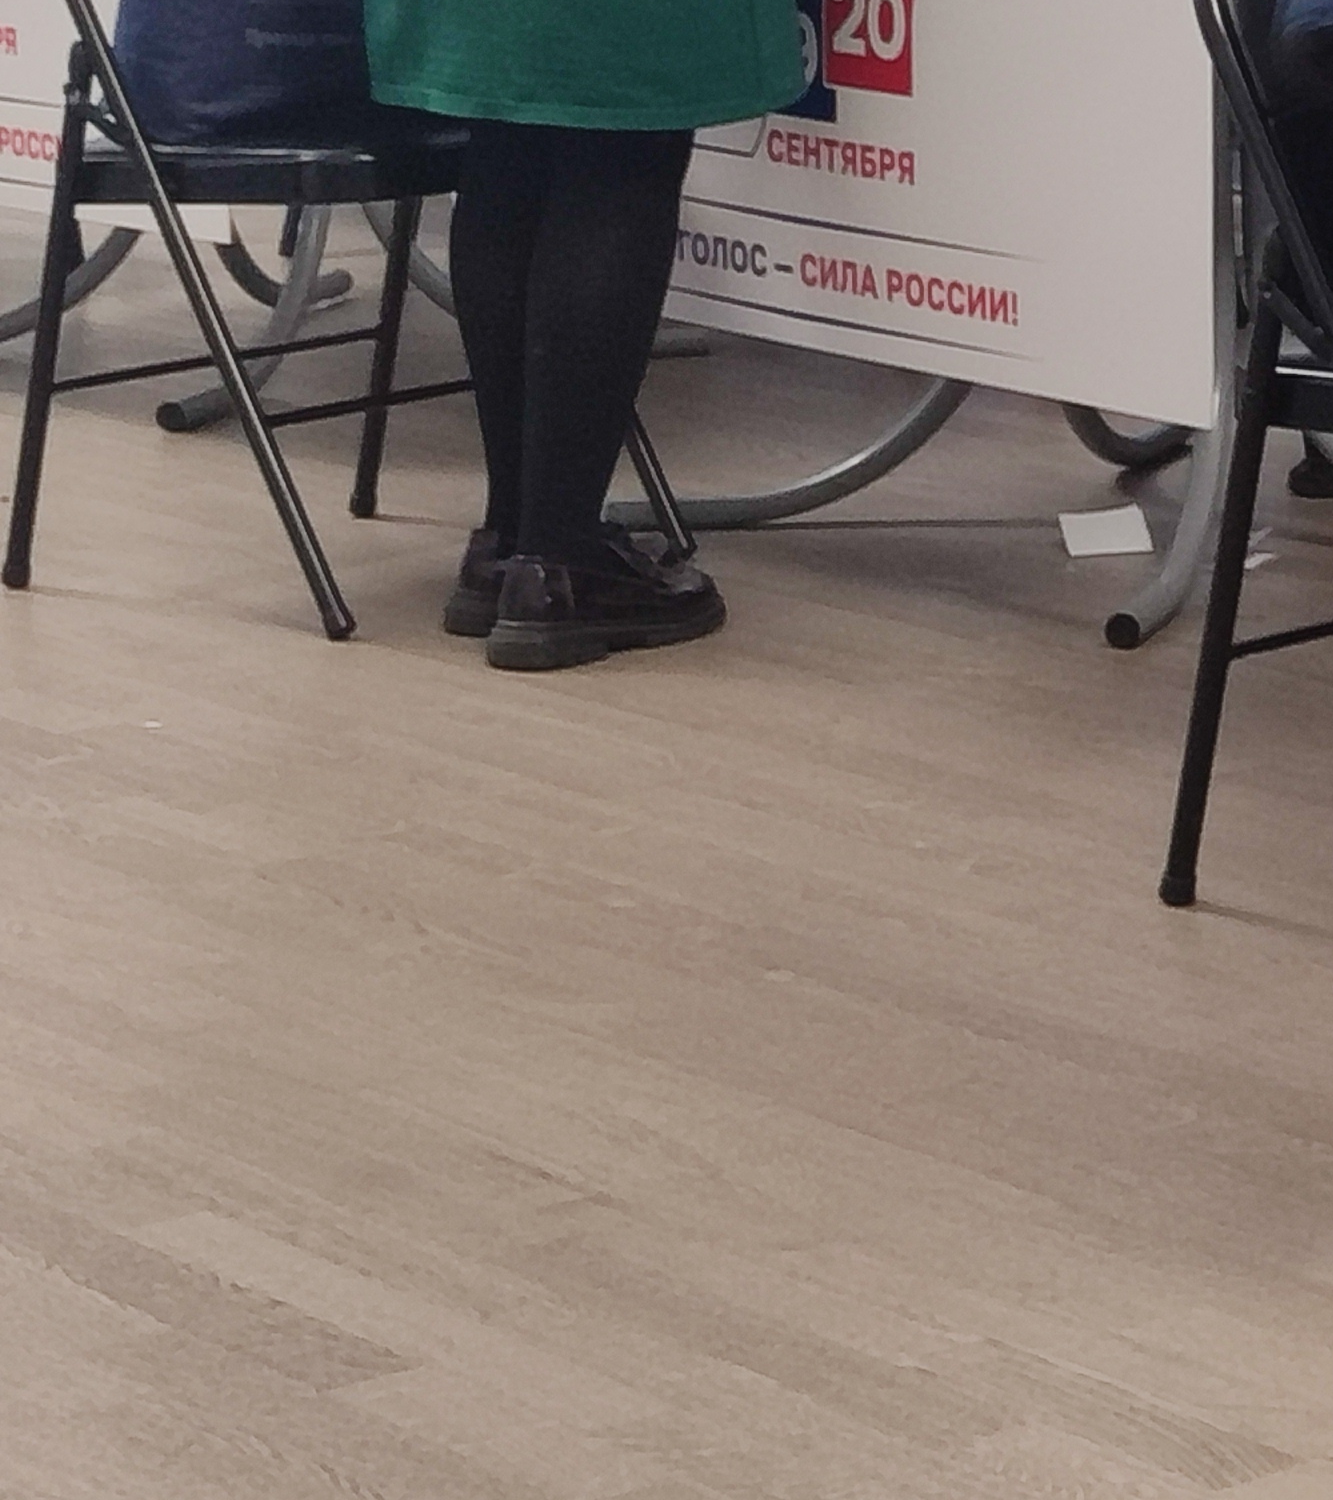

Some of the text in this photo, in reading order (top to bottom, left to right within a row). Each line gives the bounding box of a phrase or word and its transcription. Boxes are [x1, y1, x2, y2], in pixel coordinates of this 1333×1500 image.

[0, 126, 62, 162] РОСС
[767, 128, 916, 186] СЕНТЯБРЯ
[800, 252, 879, 300] СИЛА
[886, 267, 1019, 327] РОССИИ!
